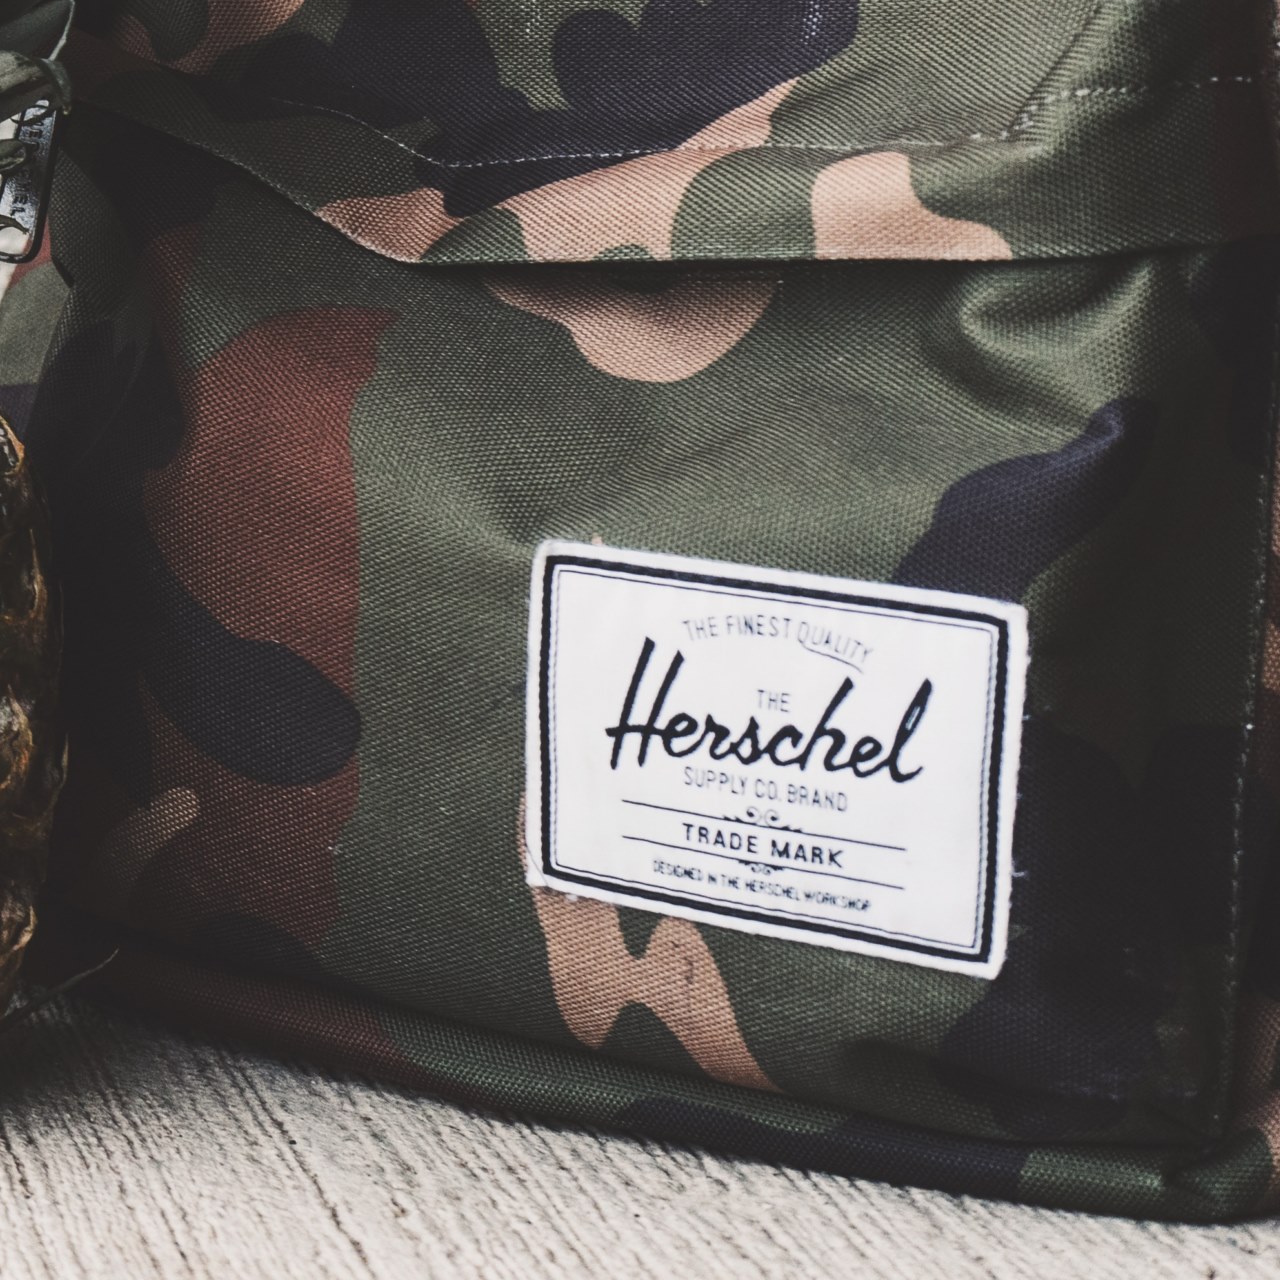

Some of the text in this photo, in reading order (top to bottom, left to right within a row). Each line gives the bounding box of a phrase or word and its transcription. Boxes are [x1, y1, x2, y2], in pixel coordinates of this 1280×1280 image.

[682, 614, 873, 665] THE FINEST QUALITY
[605, 637, 933, 783] Herschel
[756, 689, 791, 713] THE
[683, 766, 848, 812] SUPPLY CO. BRAND
[682, 822, 844, 868] TRADE MARK
[653, 860, 703, 881] DESIGNED
[707, 874, 718, 885] IN
[722, 874, 739, 890] THE
[745, 881, 800, 902] HERSCHEL
